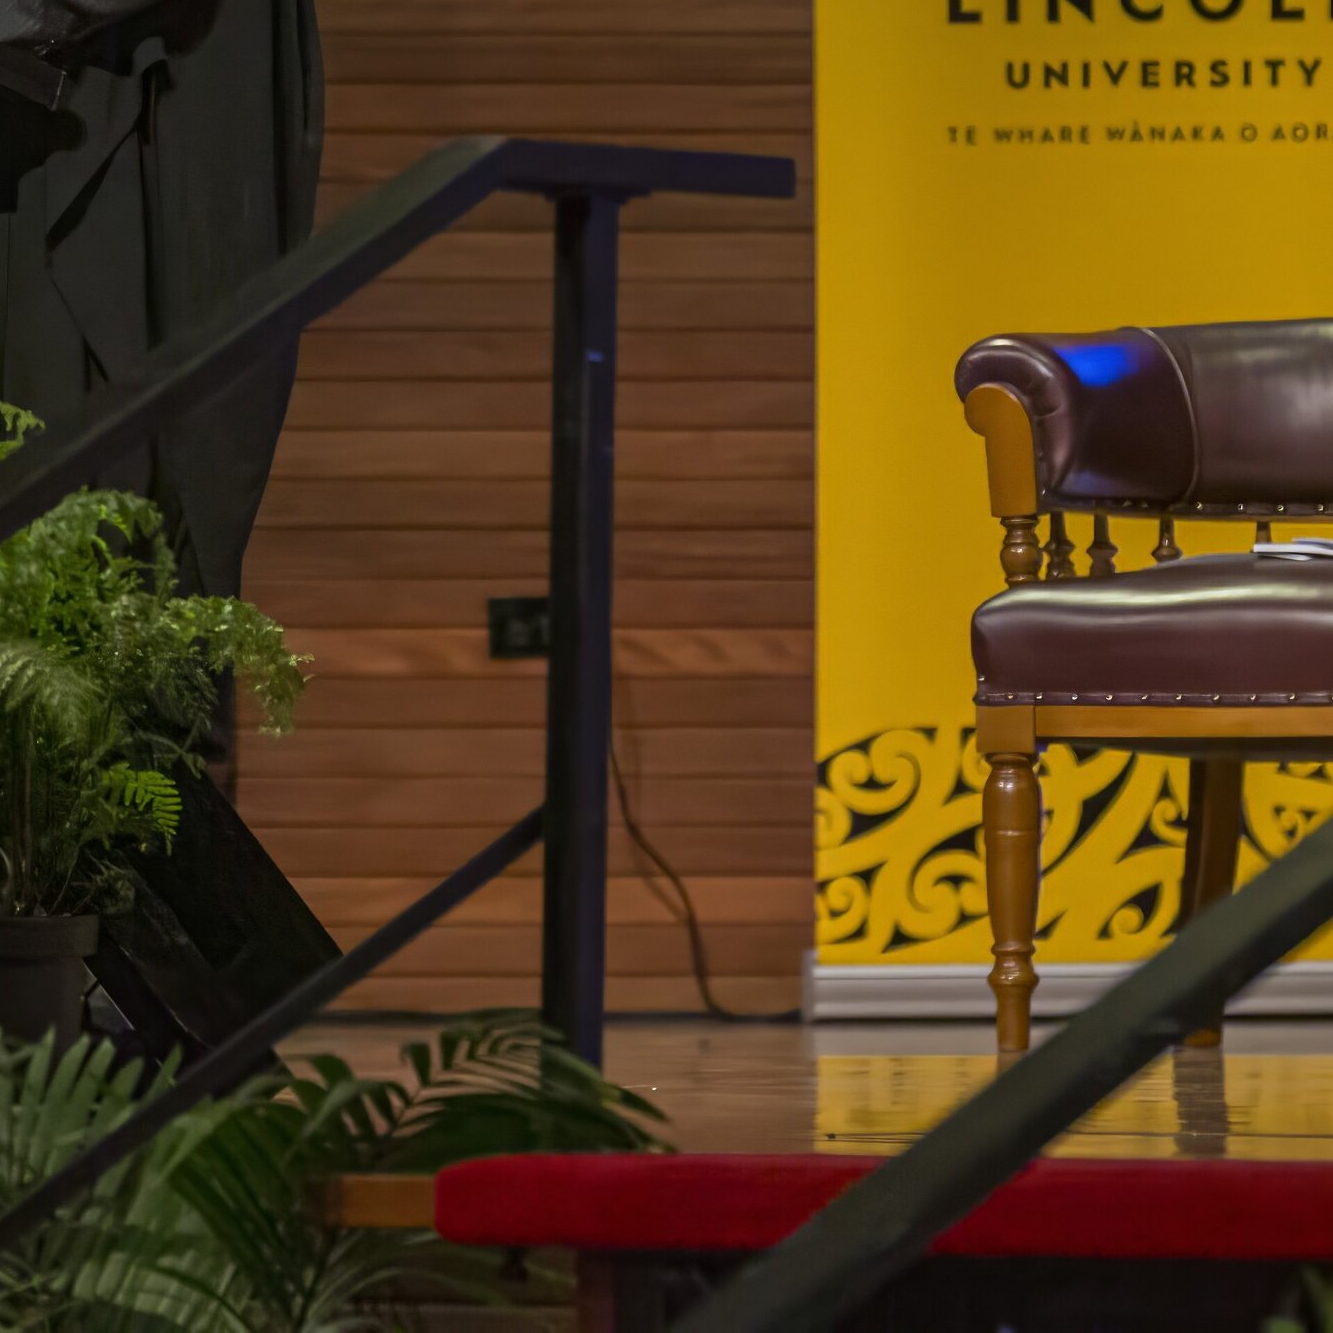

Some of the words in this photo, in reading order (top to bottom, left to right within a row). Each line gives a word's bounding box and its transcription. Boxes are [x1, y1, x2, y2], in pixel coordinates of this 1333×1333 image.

[1006, 58, 1322, 89] UNIVERSITY
[947, 126, 977, 146] TE
[994, 125, 1091, 145] WHARE
[1241, 124, 1258, 143] O
